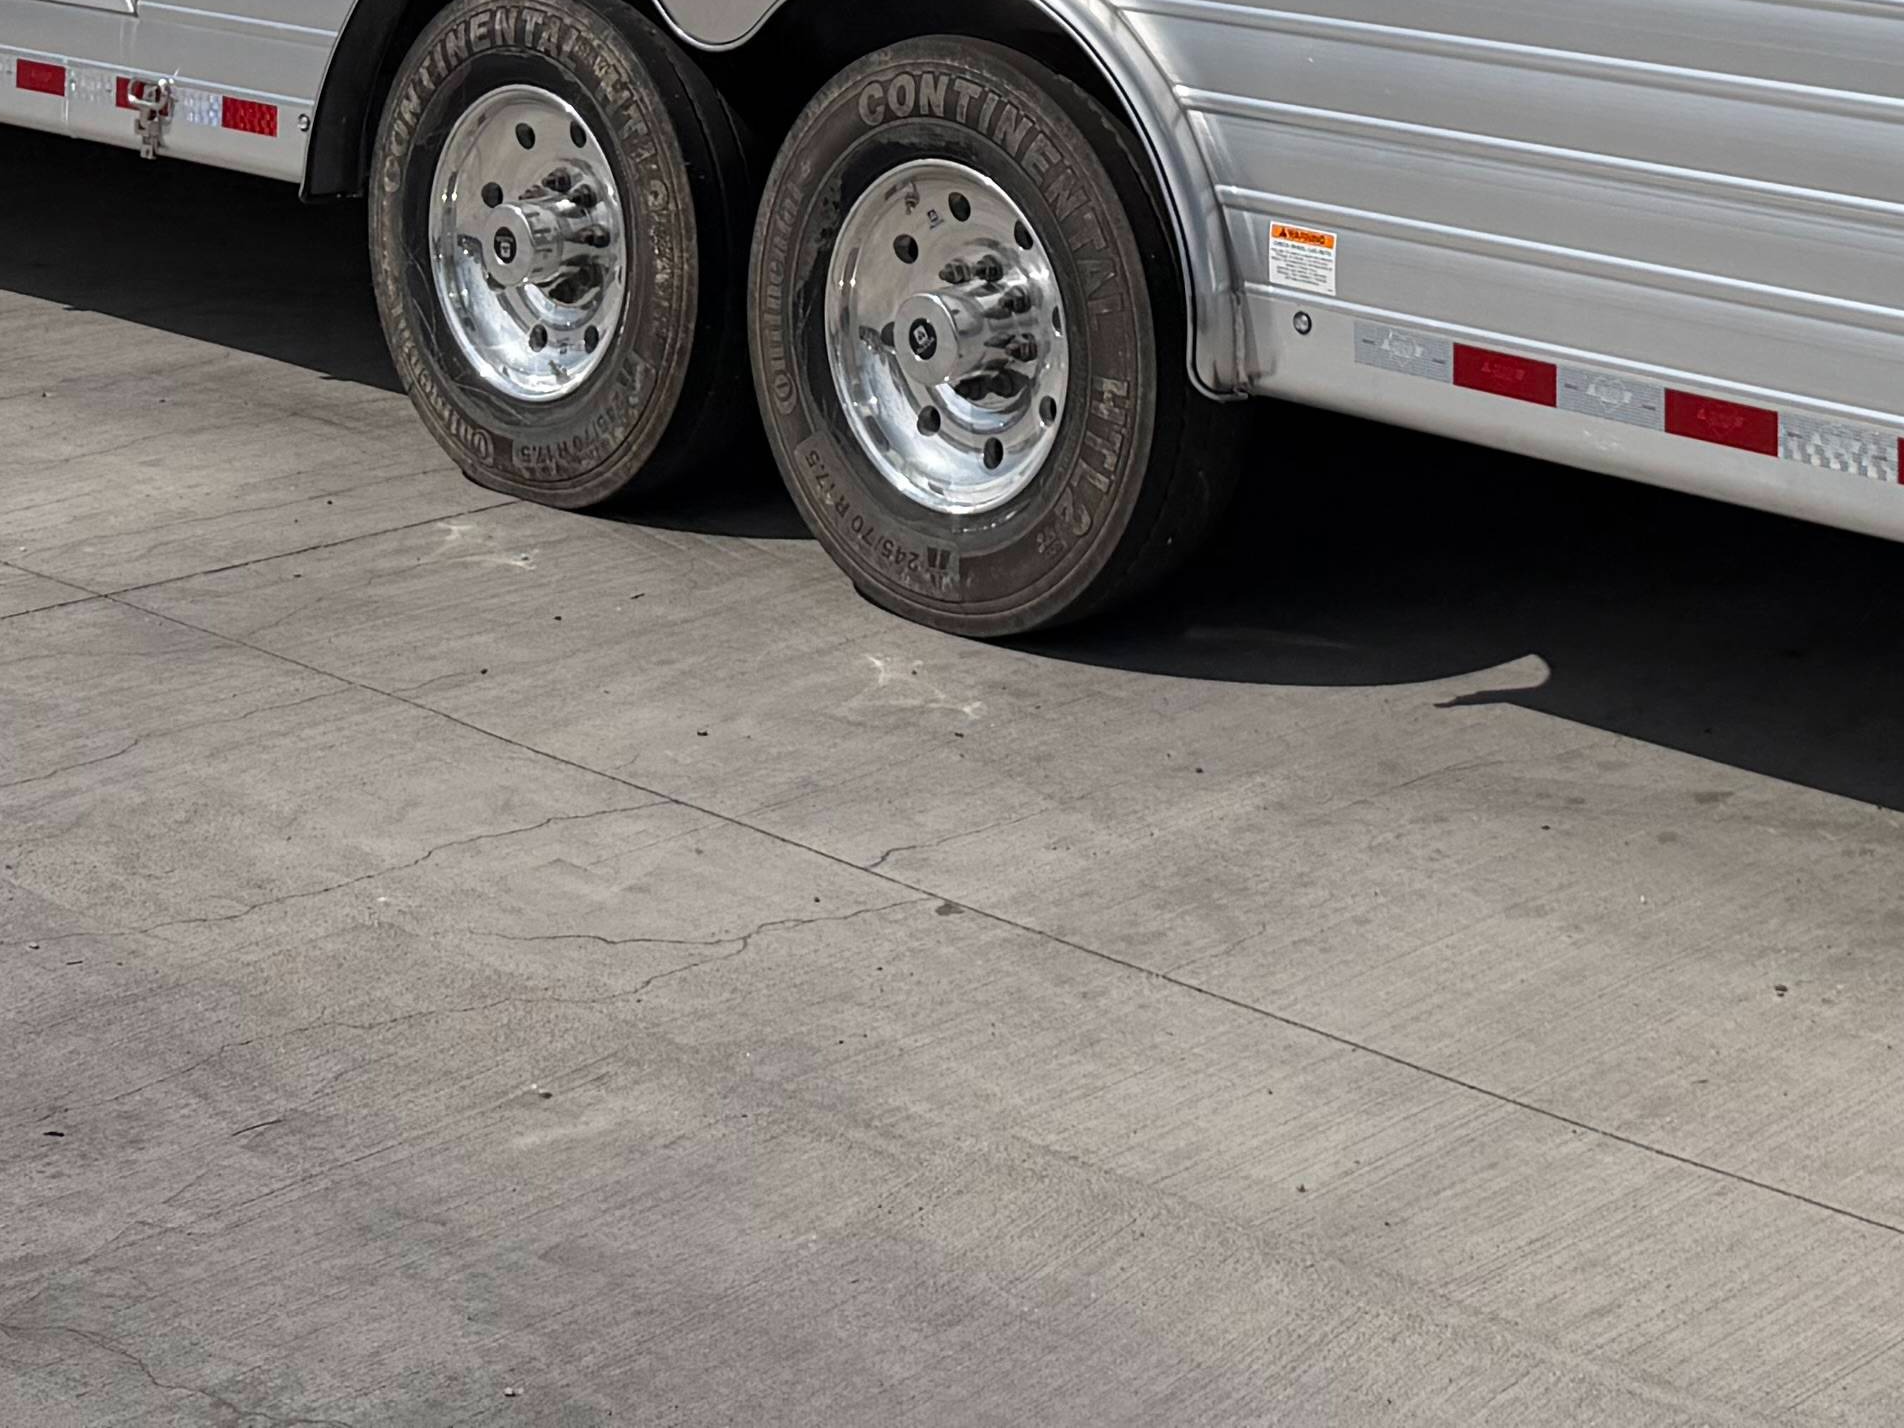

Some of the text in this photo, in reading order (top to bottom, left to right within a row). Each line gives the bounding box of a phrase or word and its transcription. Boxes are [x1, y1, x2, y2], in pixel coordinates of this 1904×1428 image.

[858, 70, 1123, 331] CONTINENTAL
[834, 496, 851, 519] R
[851, 515, 919, 572] 245/70
